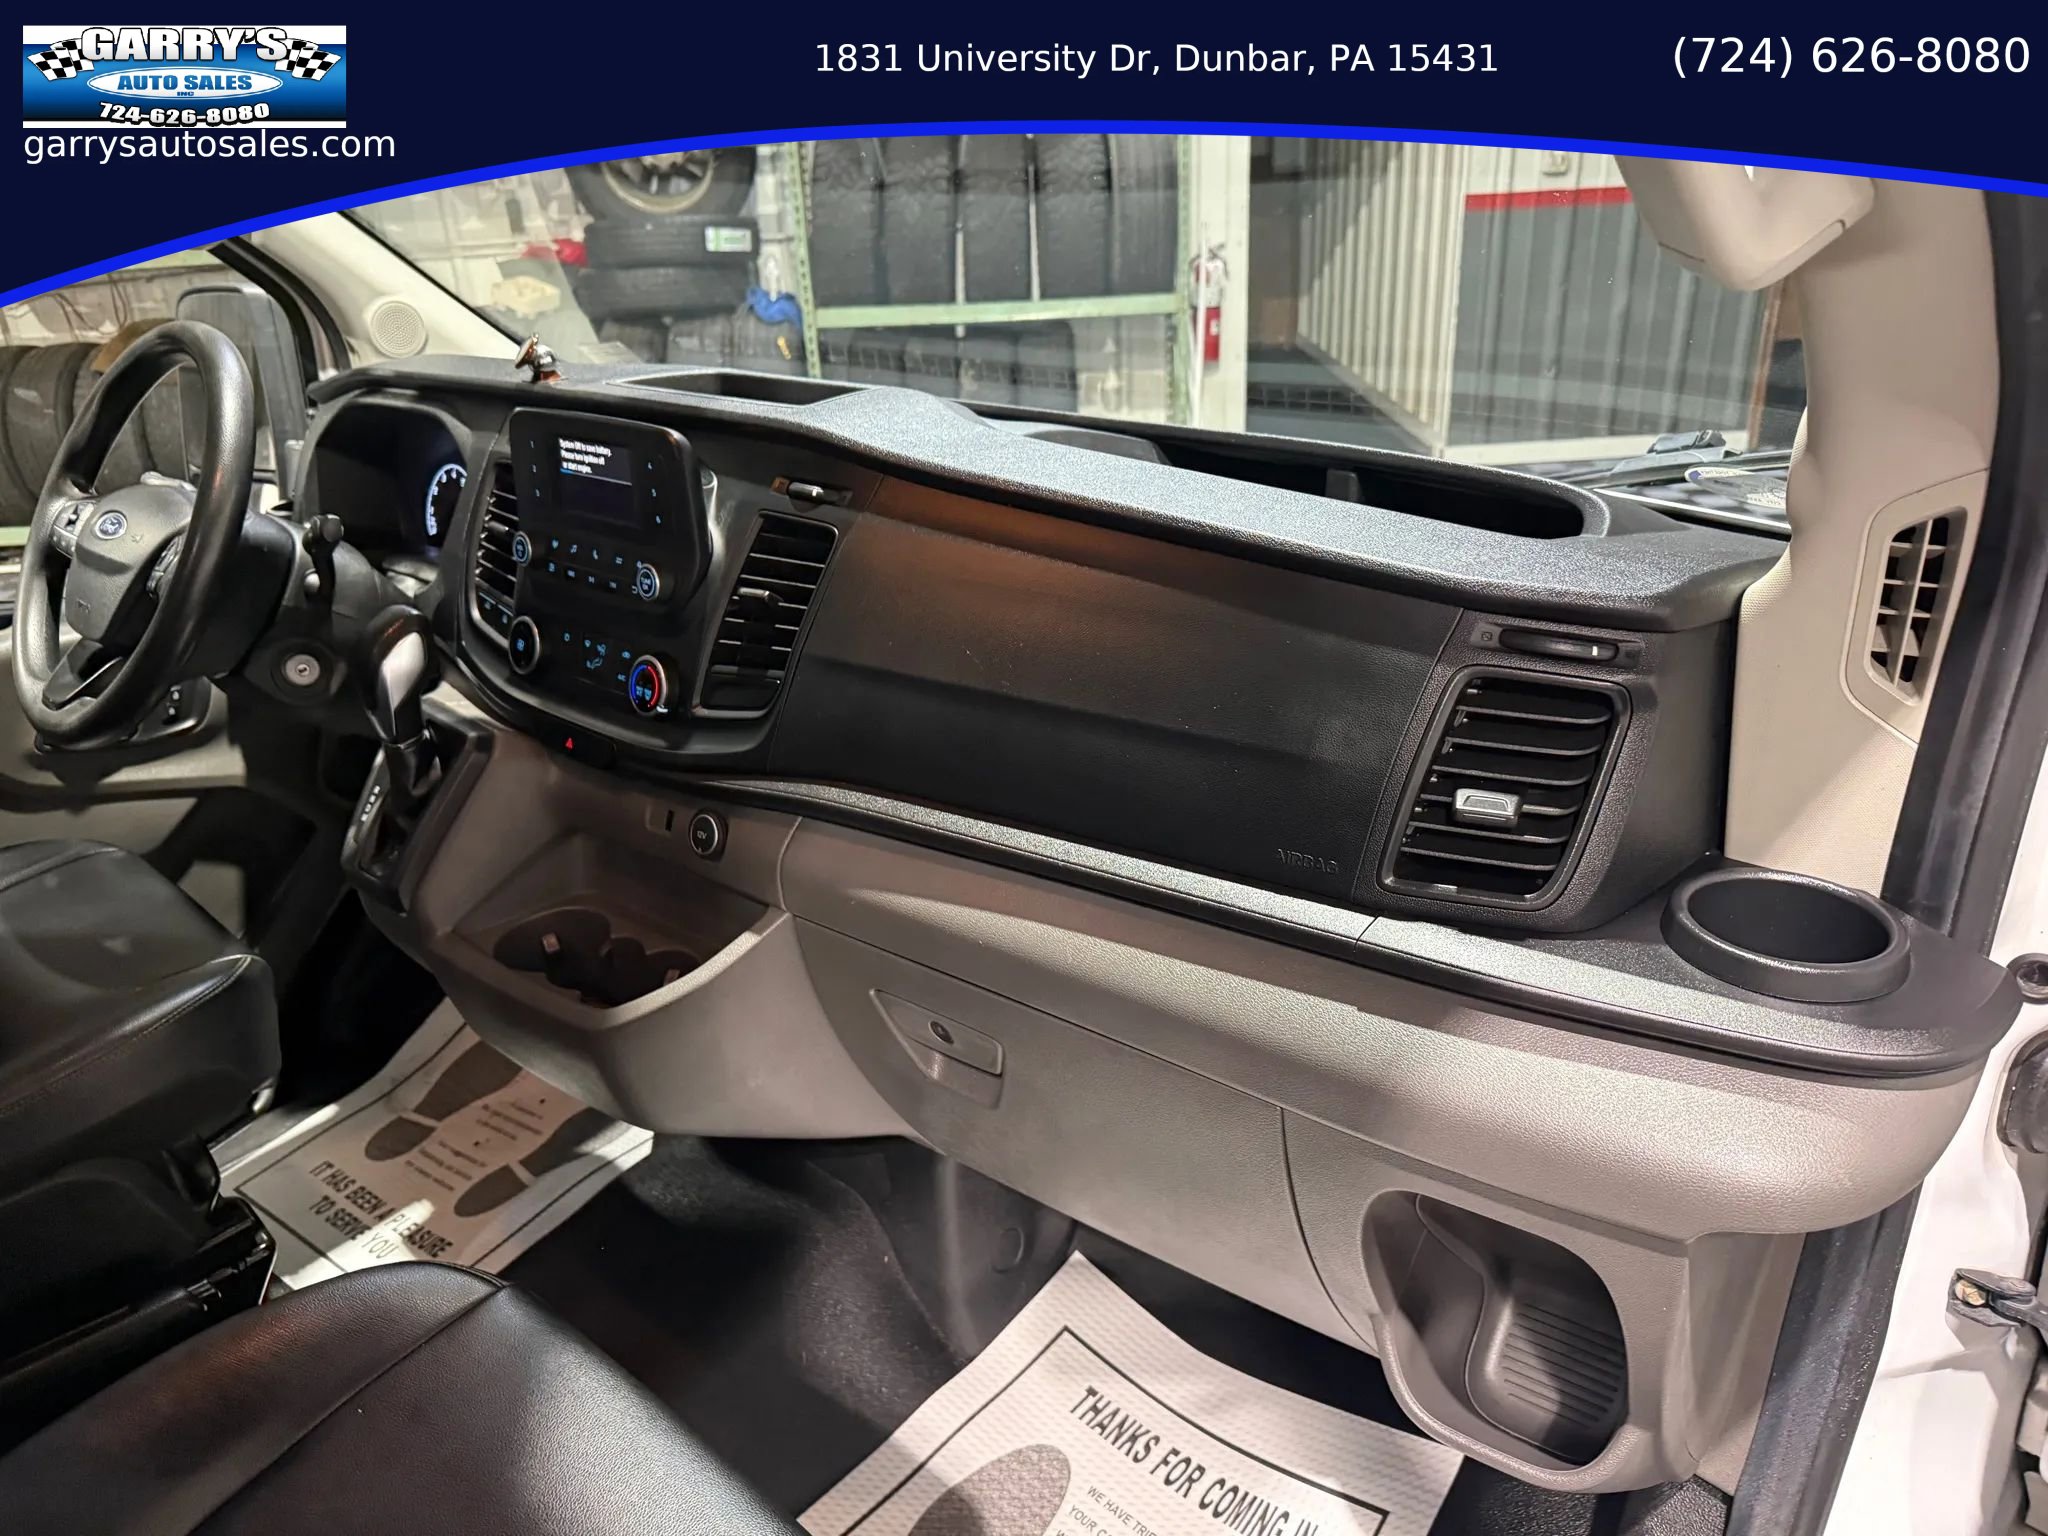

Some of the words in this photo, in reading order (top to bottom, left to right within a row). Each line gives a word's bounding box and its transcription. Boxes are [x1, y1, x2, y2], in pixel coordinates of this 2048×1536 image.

[1277, 848, 1338, 874] AIRBAG
[309, 1160, 335, 1177] IT
[320, 1169, 356, 1192] HAS
[344, 1186, 387, 1215] BEEN
[309, 1195, 336, 1215] TO
[324, 1207, 372, 1241] SERVE
[362, 1231, 399, 1259] YOU
[384, 1214, 454, 1258] PLEASURE
[1070, 1385, 1161, 1464] THANKS
[1149, 1447, 1206, 1499] FOR
[1199, 1477, 1290, 1536] COMING
[1068, 1504, 1098, 1533] YOUR
[1087, 1485, 1106, 1504] WE
[1102, 1498, 1134, 1526] HAVE
